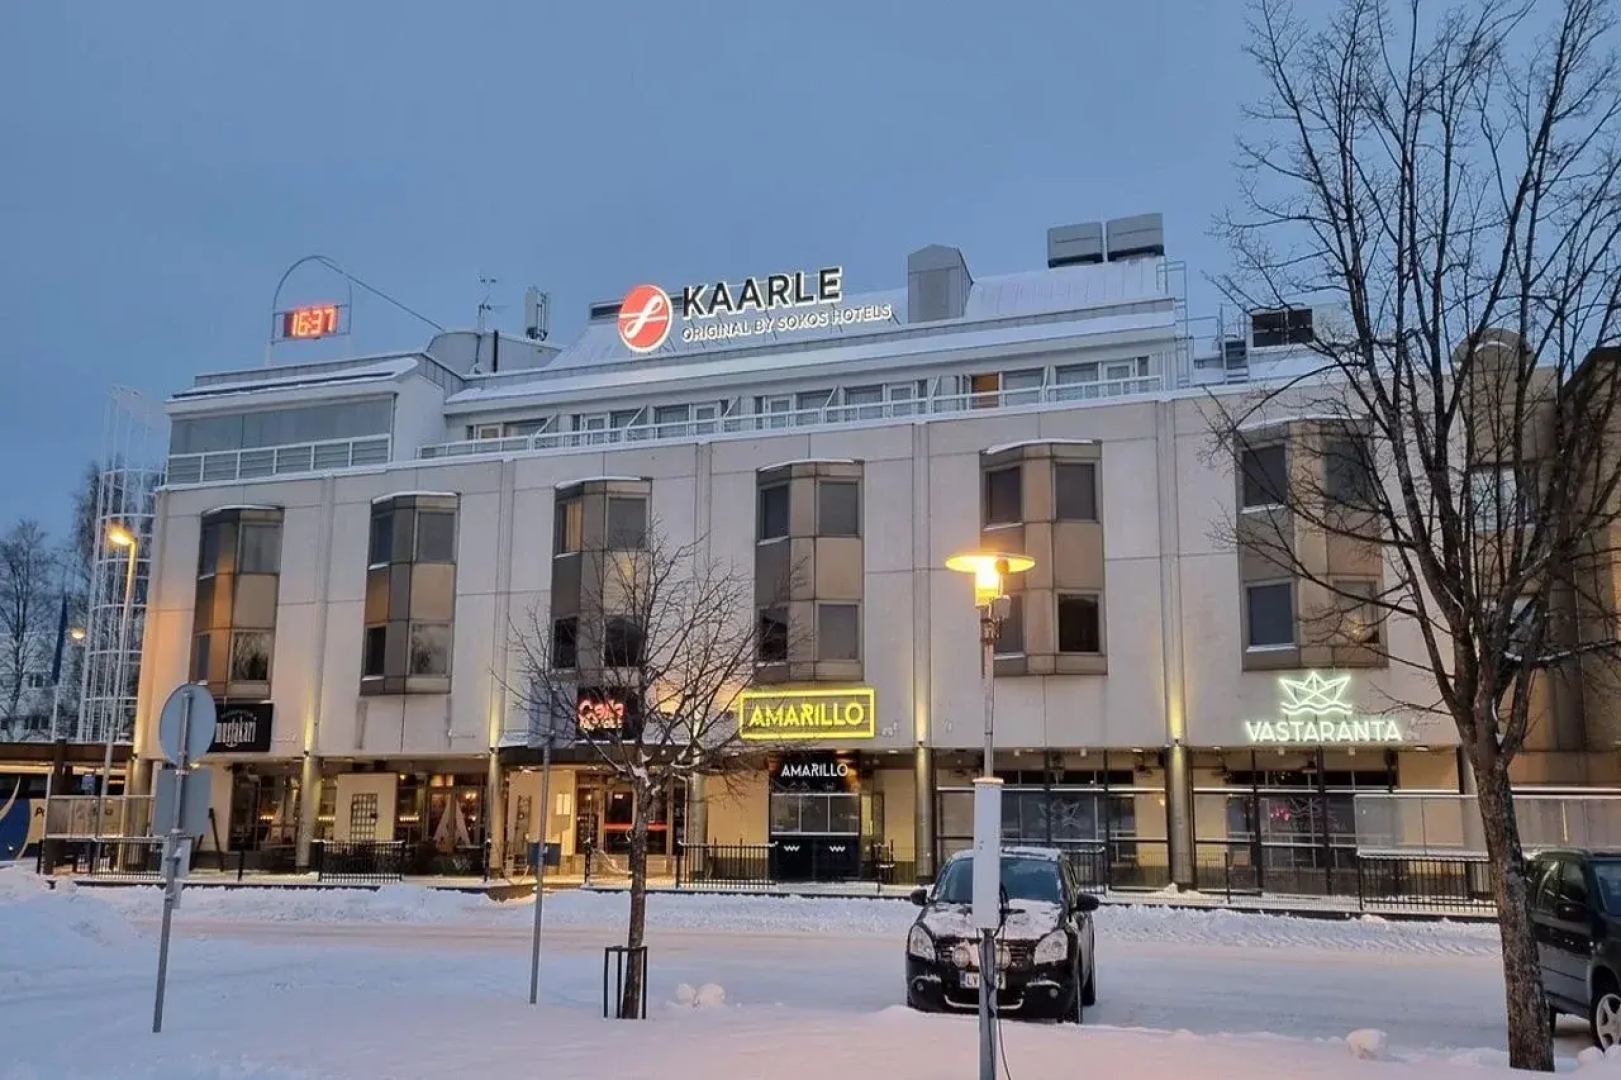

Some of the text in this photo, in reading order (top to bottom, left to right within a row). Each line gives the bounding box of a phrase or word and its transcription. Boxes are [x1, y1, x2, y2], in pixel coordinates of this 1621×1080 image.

[682, 266, 842, 320] KAARLE
[682, 303, 893, 343] ORIGINAL BY SOKOS HOTELS
[749, 701, 865, 728] AMARILLO
[1245, 720, 1403, 742] VASTARANTA
[781, 762, 848, 777] AMARILLO
